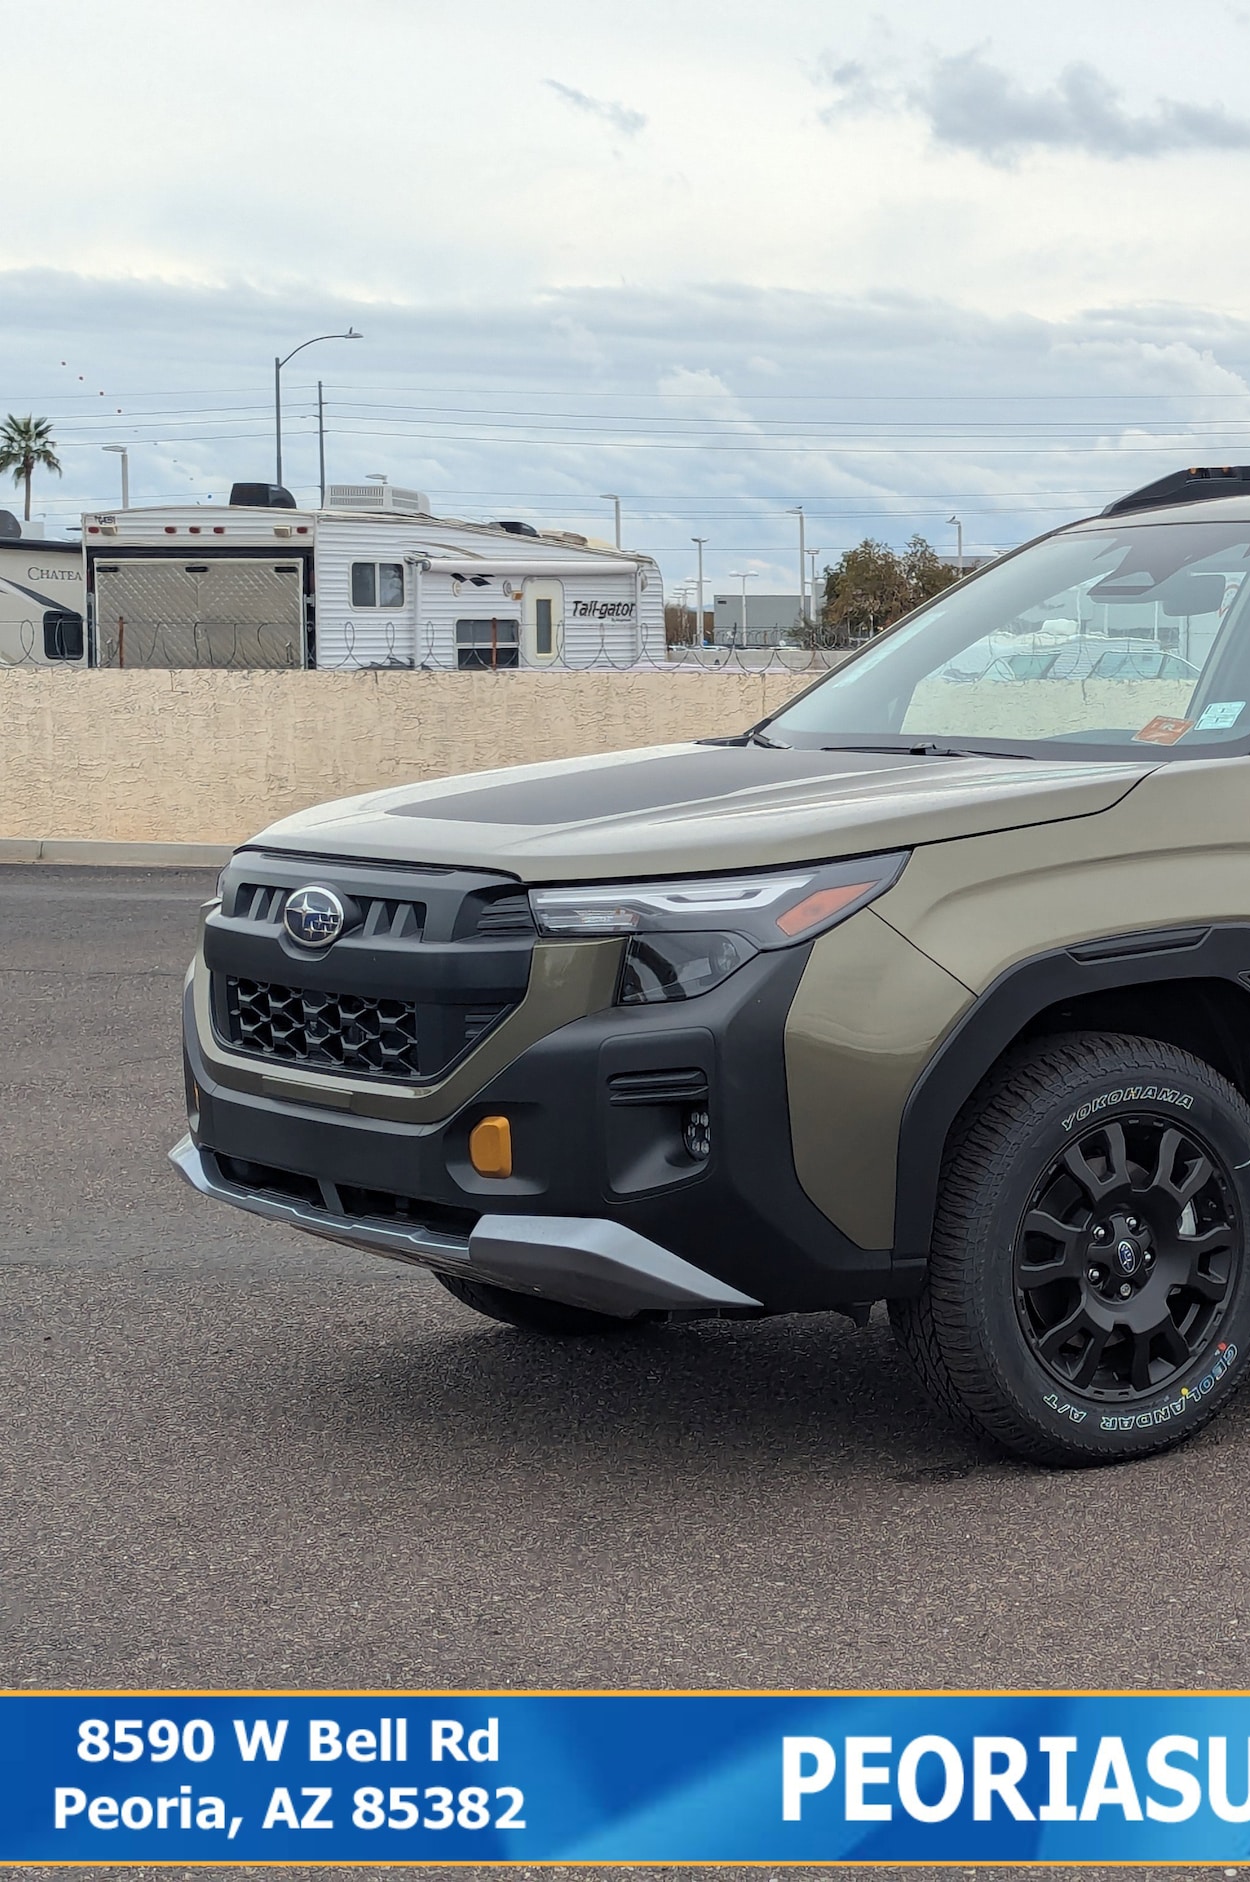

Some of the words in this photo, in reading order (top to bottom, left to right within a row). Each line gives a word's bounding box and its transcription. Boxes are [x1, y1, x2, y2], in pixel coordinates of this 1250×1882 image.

[573, 600, 636, 619] Tail-gator
[1061, 1086, 1194, 1131] YOKOHAMA
[1100, 1343, 1238, 1431] GEOLANDAR
[1043, 1393, 1087, 1423] A/T
